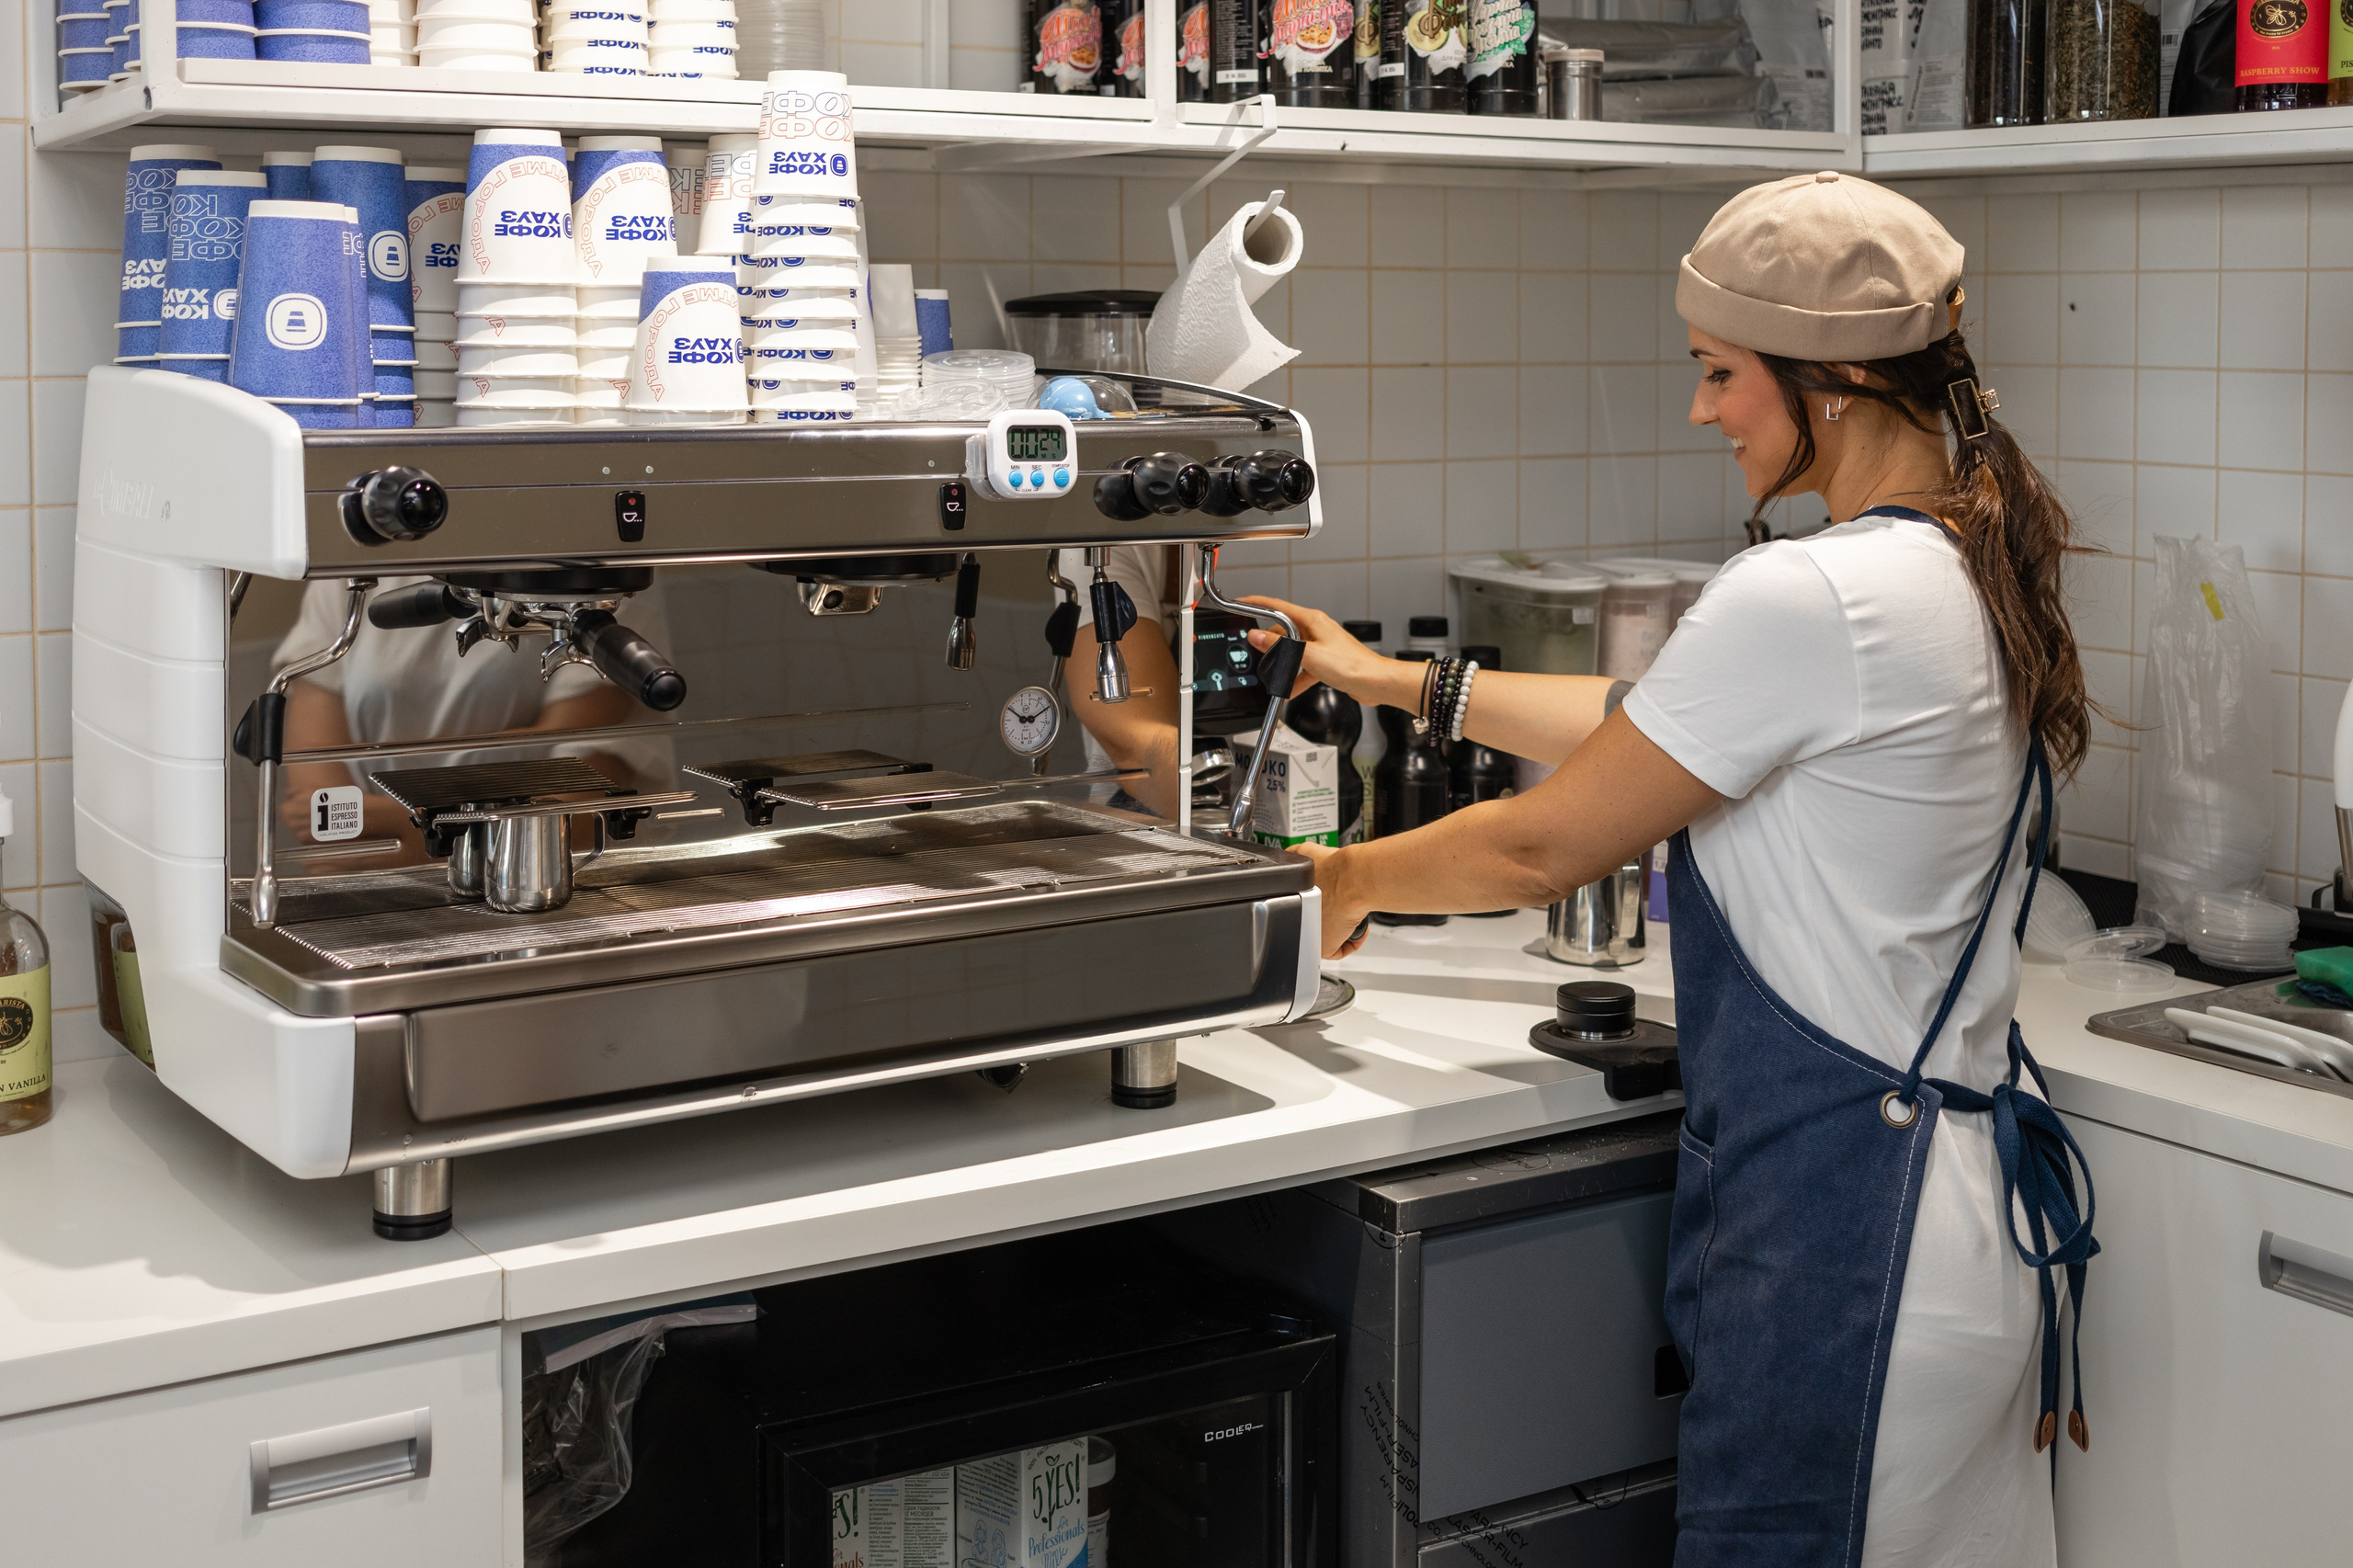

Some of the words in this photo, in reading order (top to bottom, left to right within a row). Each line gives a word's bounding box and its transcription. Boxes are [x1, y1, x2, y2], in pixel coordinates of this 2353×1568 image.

[2341, 60, 2353, 68] PIS
[2240, 67, 2287, 77] RASPBERRY
[774, 152, 826, 164] ХАУЗ
[768, 163, 827, 176] КОФЕ
[500, 210, 561, 224] ХАУЗ
[611, 215, 666, 228] ХАУЗ
[494, 223, 561, 238] КОФЕ
[606, 229, 667, 241] КОФЕ
[125, 258, 166, 274] АУЗ
[121, 274, 165, 290] ОФЕ
[674, 337, 732, 350] ХАУЗ
[668, 351, 733, 364] КОФЕ
[1235, 752, 1287, 777] МОКО
[331, 801, 358, 812] ISTITUTO
[331, 811, 358, 821] ESPRESSO
[331, 820, 358, 830] ITALIANO
[8, 1074, 46, 1090] VANILLA
[1377, 1381, 1419, 1442] CHNOLOGIES
[1364, 1385, 1418, 1468] ASER-FILM
[1029, 1517, 1086, 1558] Professionals
